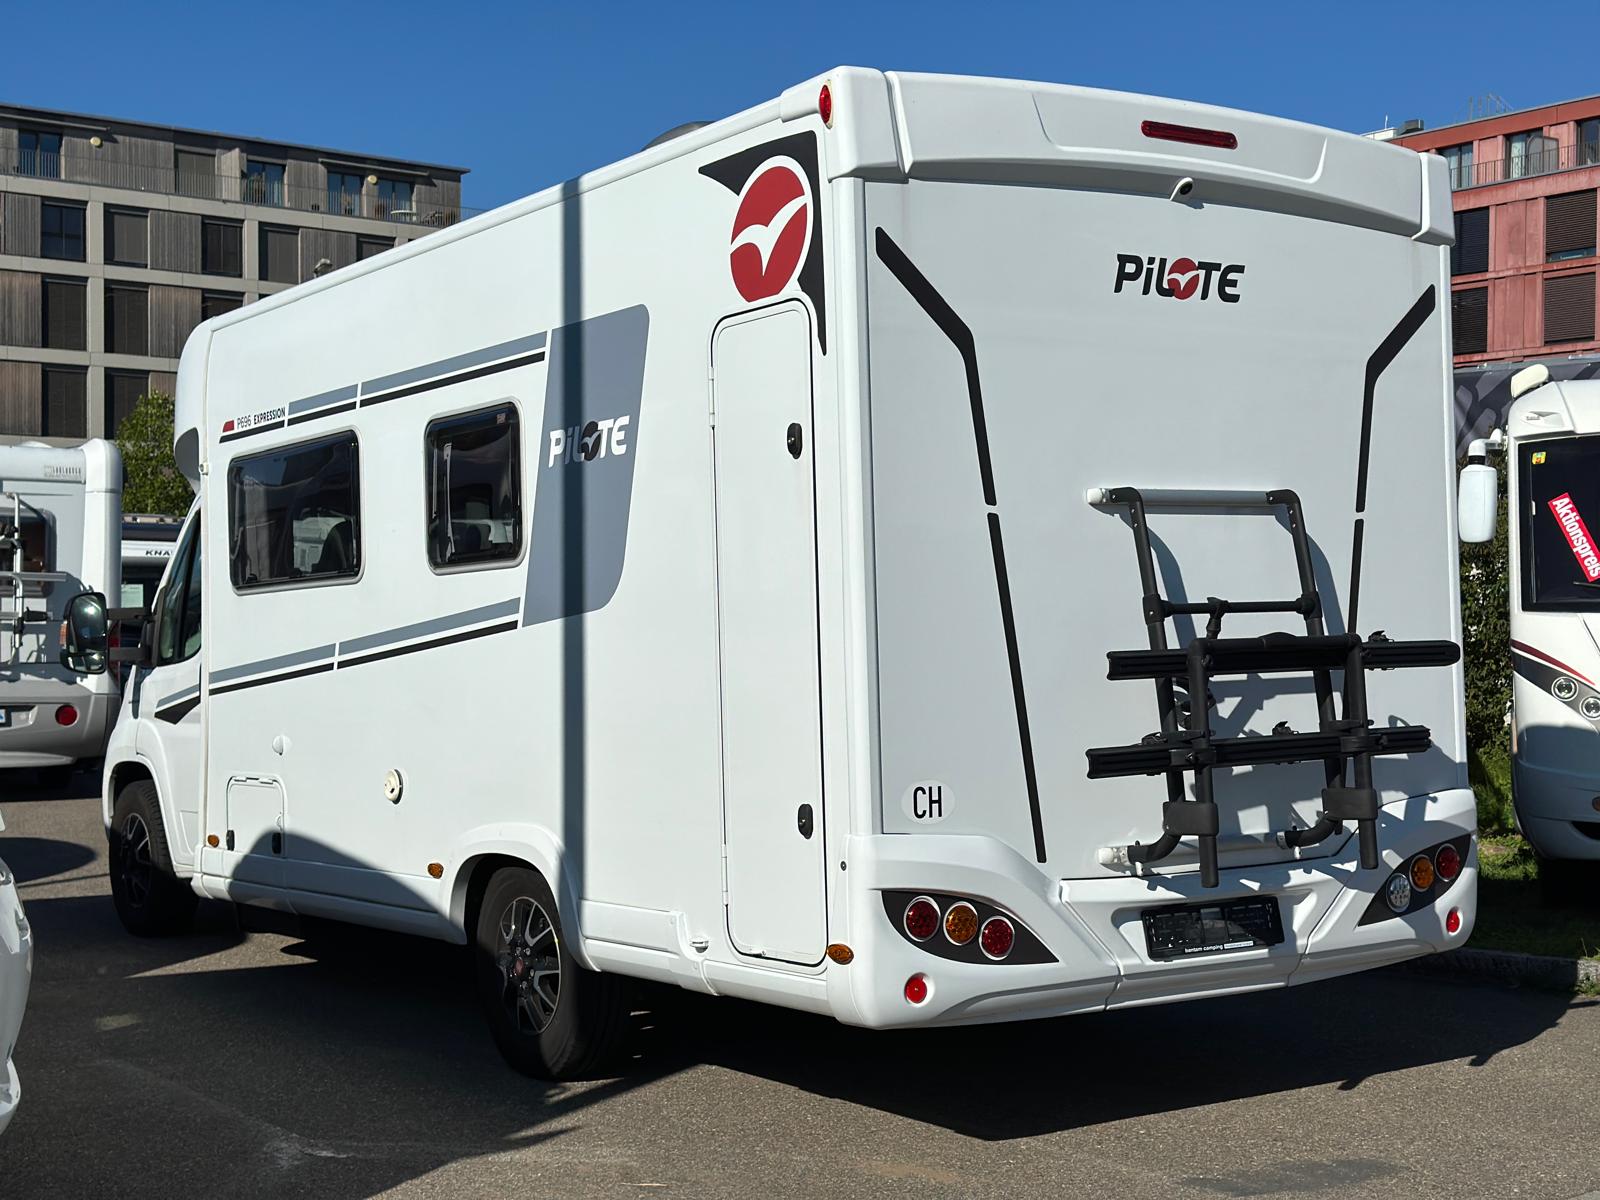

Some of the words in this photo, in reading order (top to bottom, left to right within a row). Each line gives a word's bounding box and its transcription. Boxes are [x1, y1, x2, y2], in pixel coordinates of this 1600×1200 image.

[237, 414, 251, 430] P696
[253, 406, 286, 425] EXPRESSION
[913, 785, 943, 819] CH
